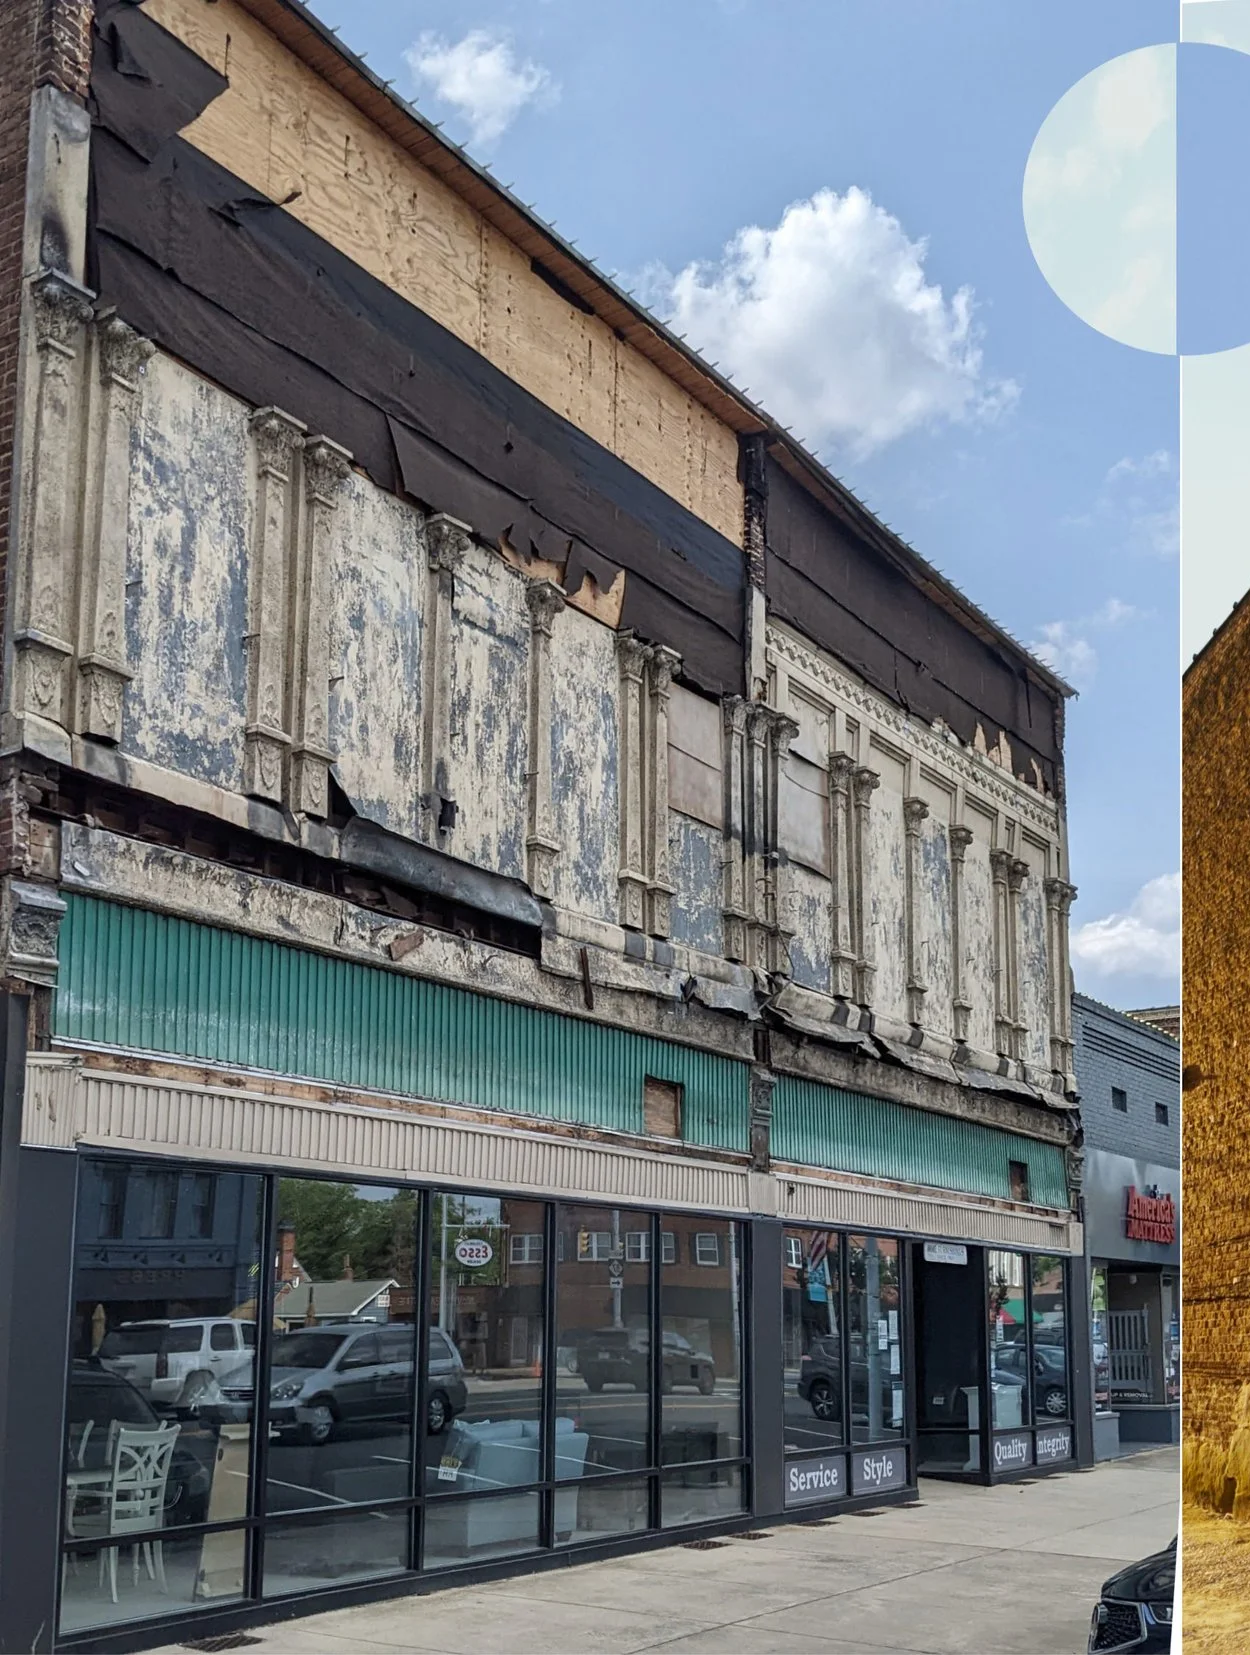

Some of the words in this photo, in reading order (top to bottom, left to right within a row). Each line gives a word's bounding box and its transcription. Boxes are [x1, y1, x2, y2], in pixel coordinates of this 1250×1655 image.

[994, 1438, 1027, 1465] Quality
[789, 1463, 838, 1492] Service
[863, 1455, 893, 1485] Style
